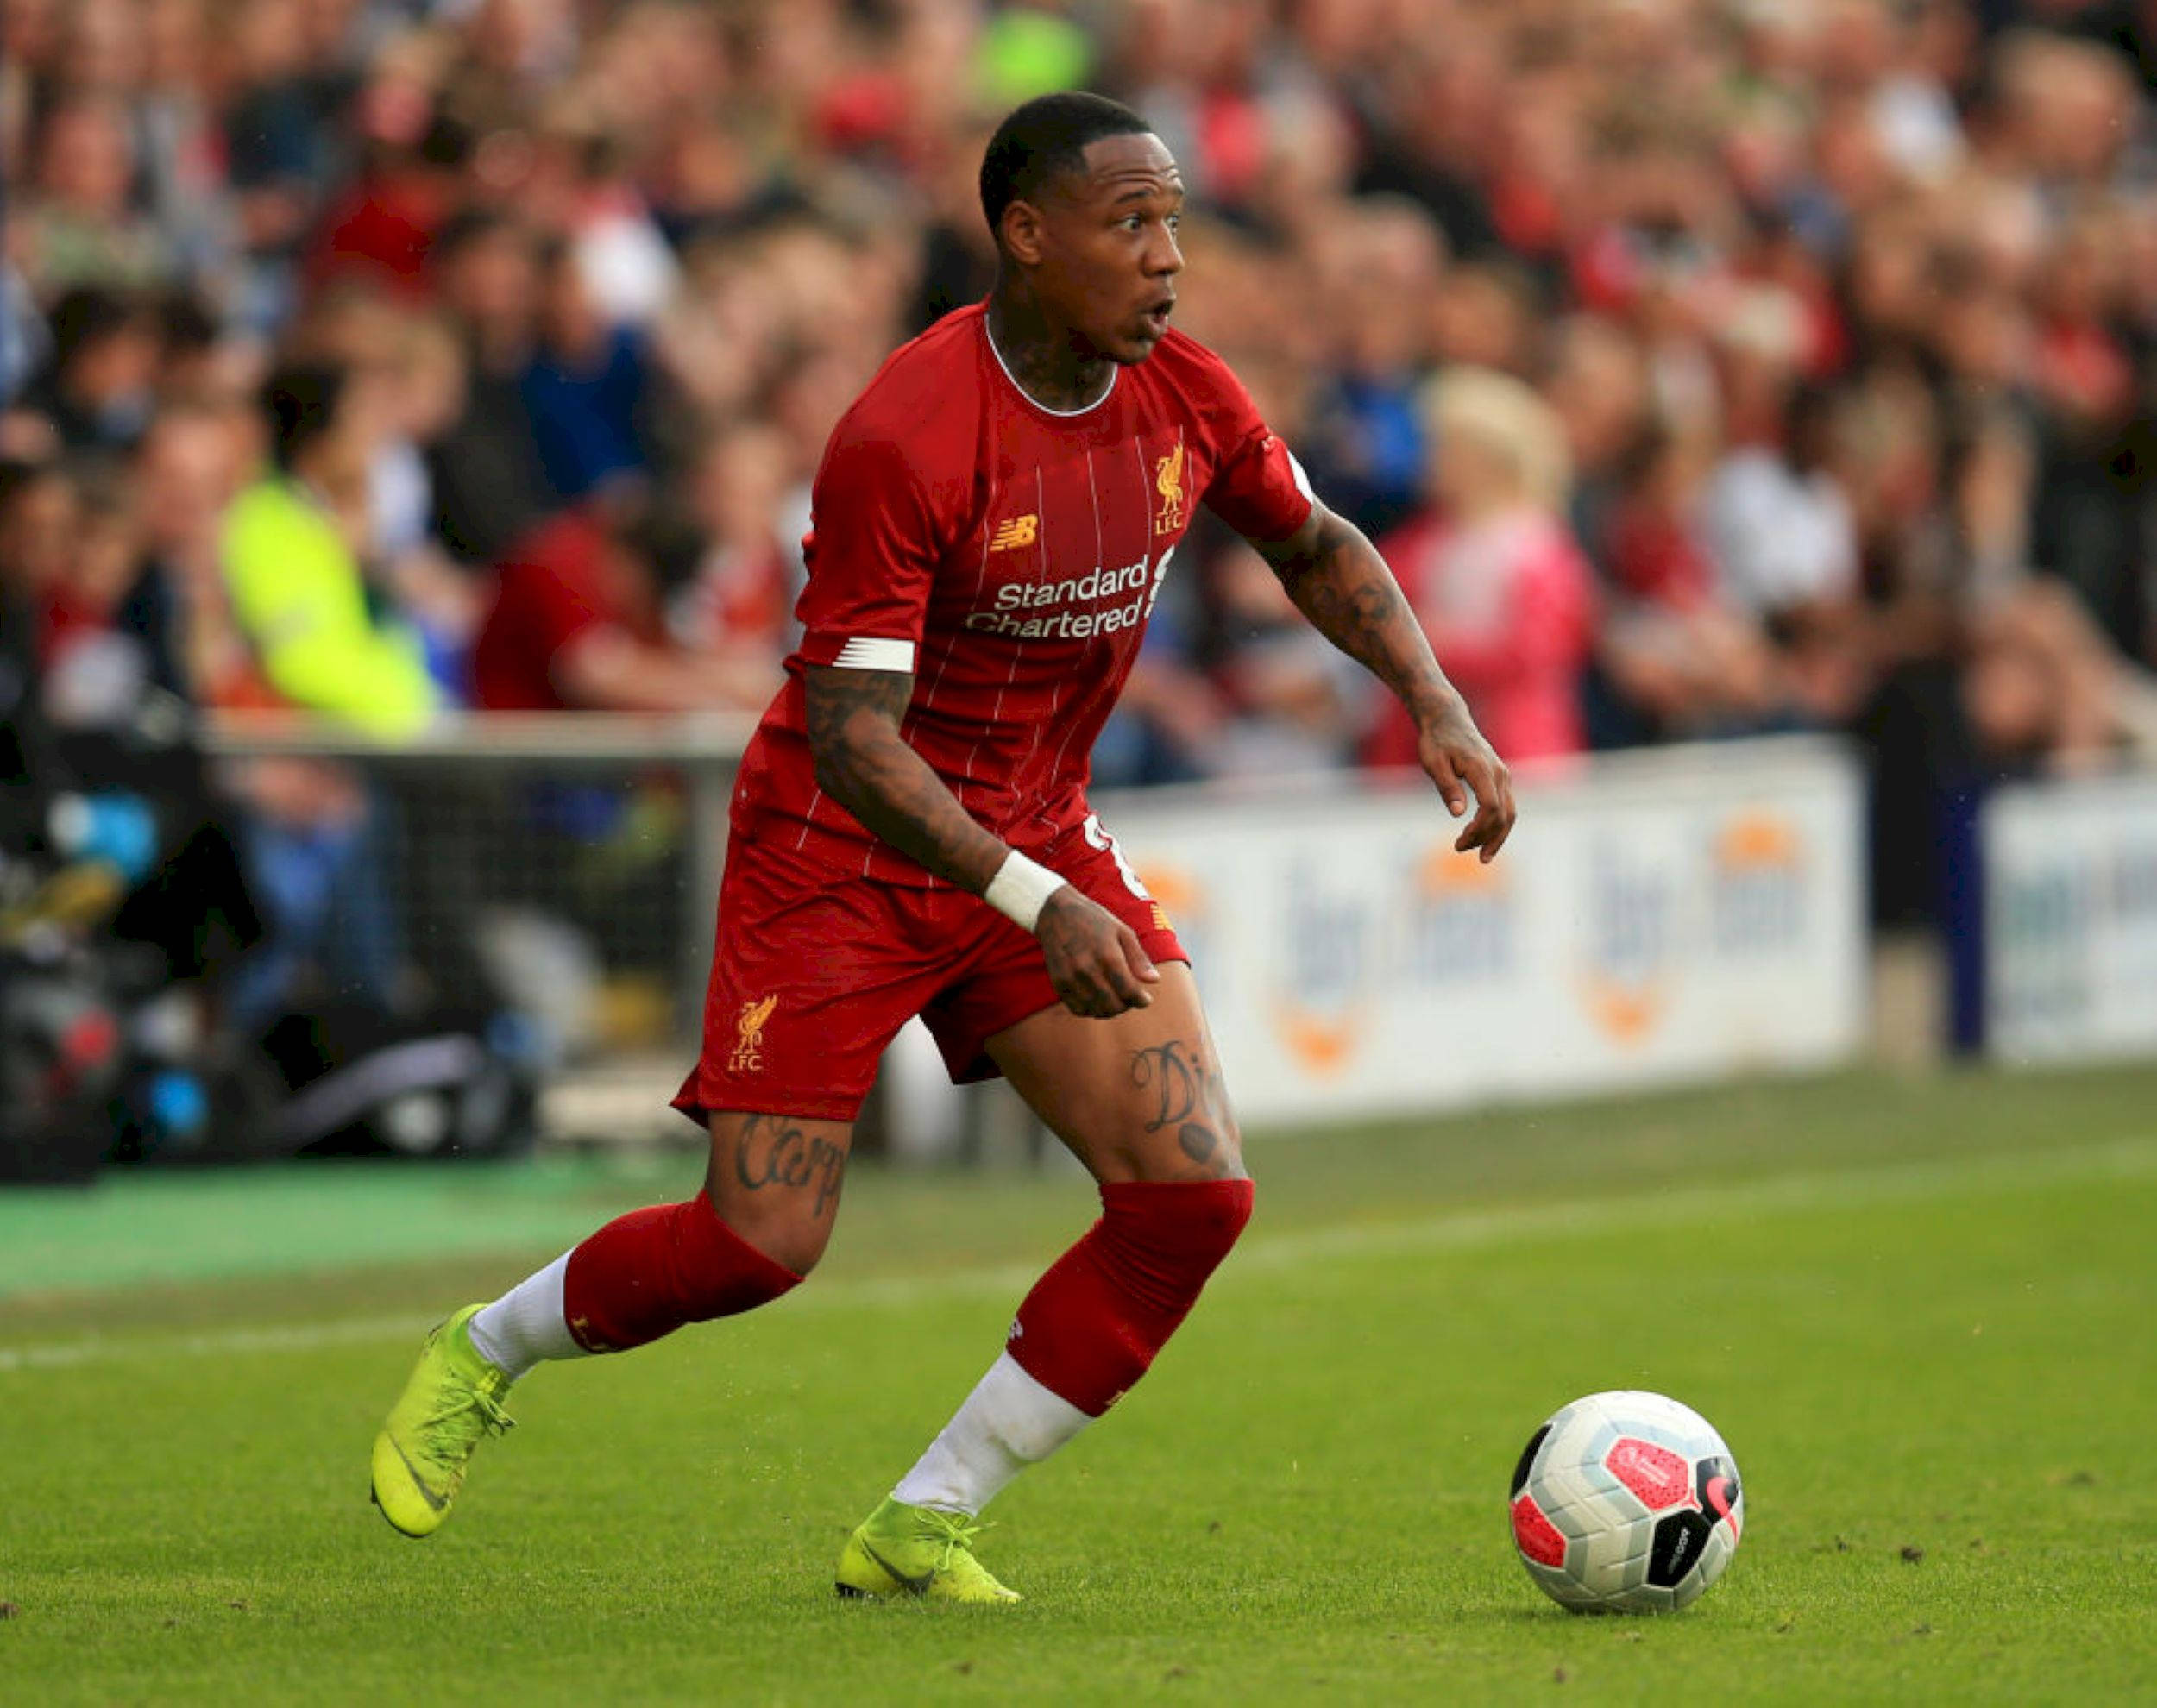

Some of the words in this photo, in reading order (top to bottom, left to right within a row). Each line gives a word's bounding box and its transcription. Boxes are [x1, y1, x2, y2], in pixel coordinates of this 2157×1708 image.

[1155, 513, 1182, 536] LFC
[994, 554, 1150, 611] Standard
[965, 594, 1142, 638] Chartered
[728, 1054, 764, 1072] LFC
